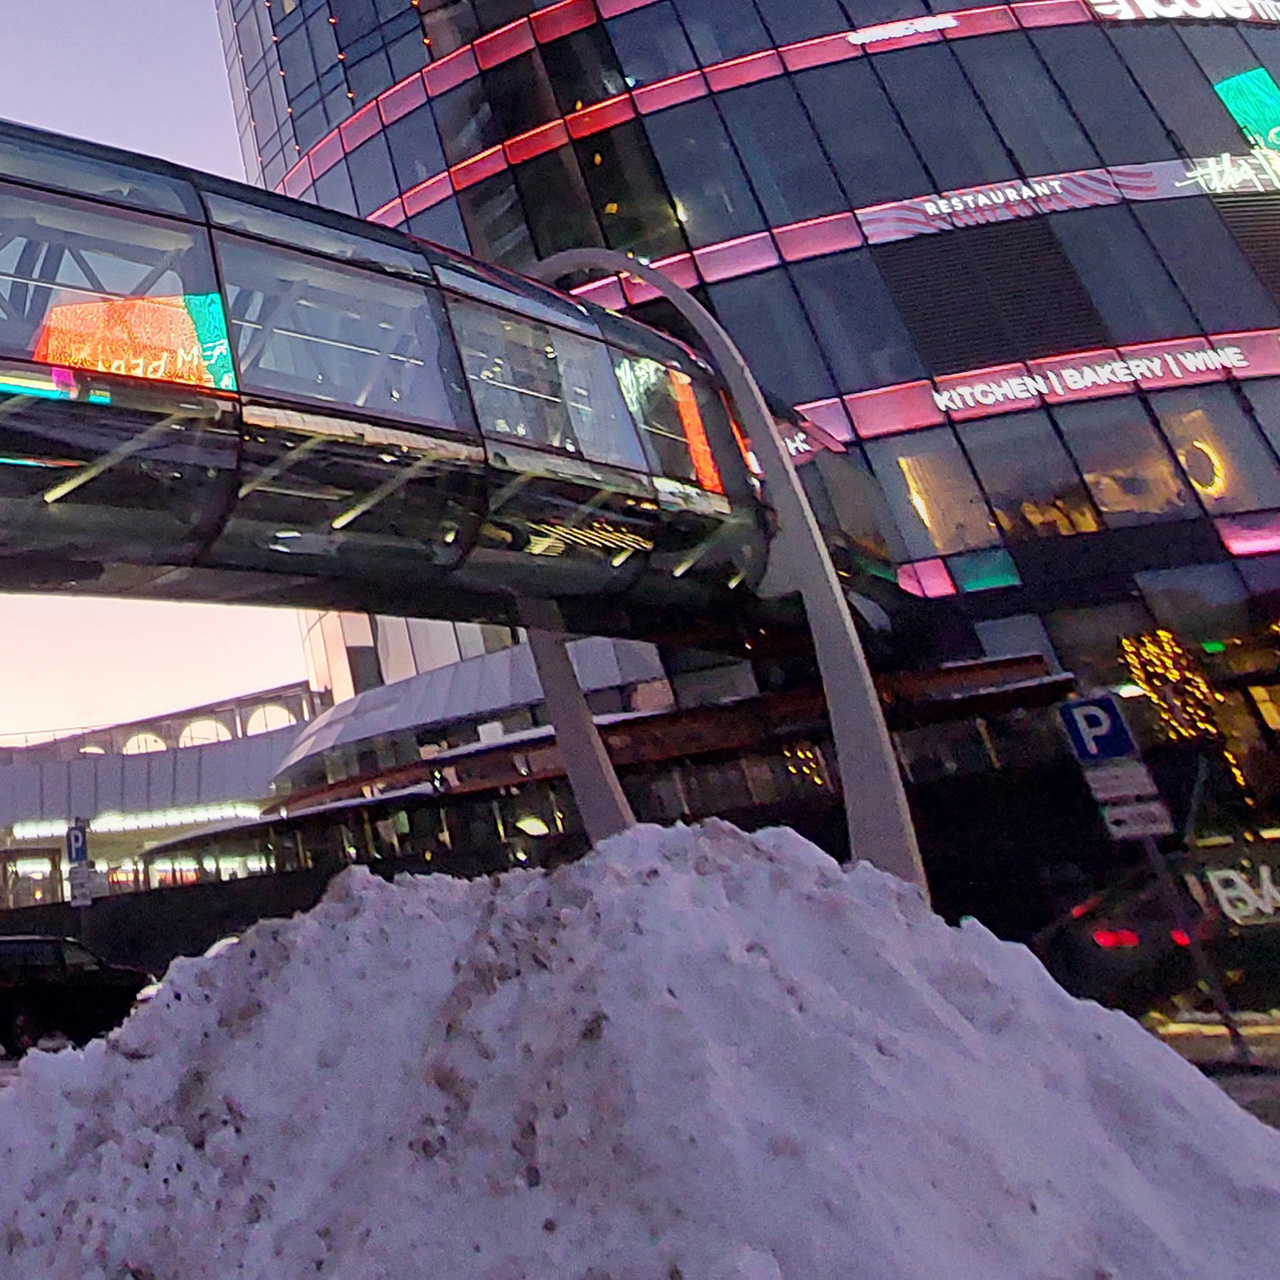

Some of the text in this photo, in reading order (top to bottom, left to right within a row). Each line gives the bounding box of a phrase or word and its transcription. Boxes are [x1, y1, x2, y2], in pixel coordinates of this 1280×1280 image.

[924, 181, 1063, 216] RESTAURANT
[933, 376, 1049, 412] KITCHEN
[1060, 357, 1163, 391] BAKERY
[1176, 346, 1250, 372] WINE
[1072, 704, 1111, 755] P
[70, 830, 84, 860] P
